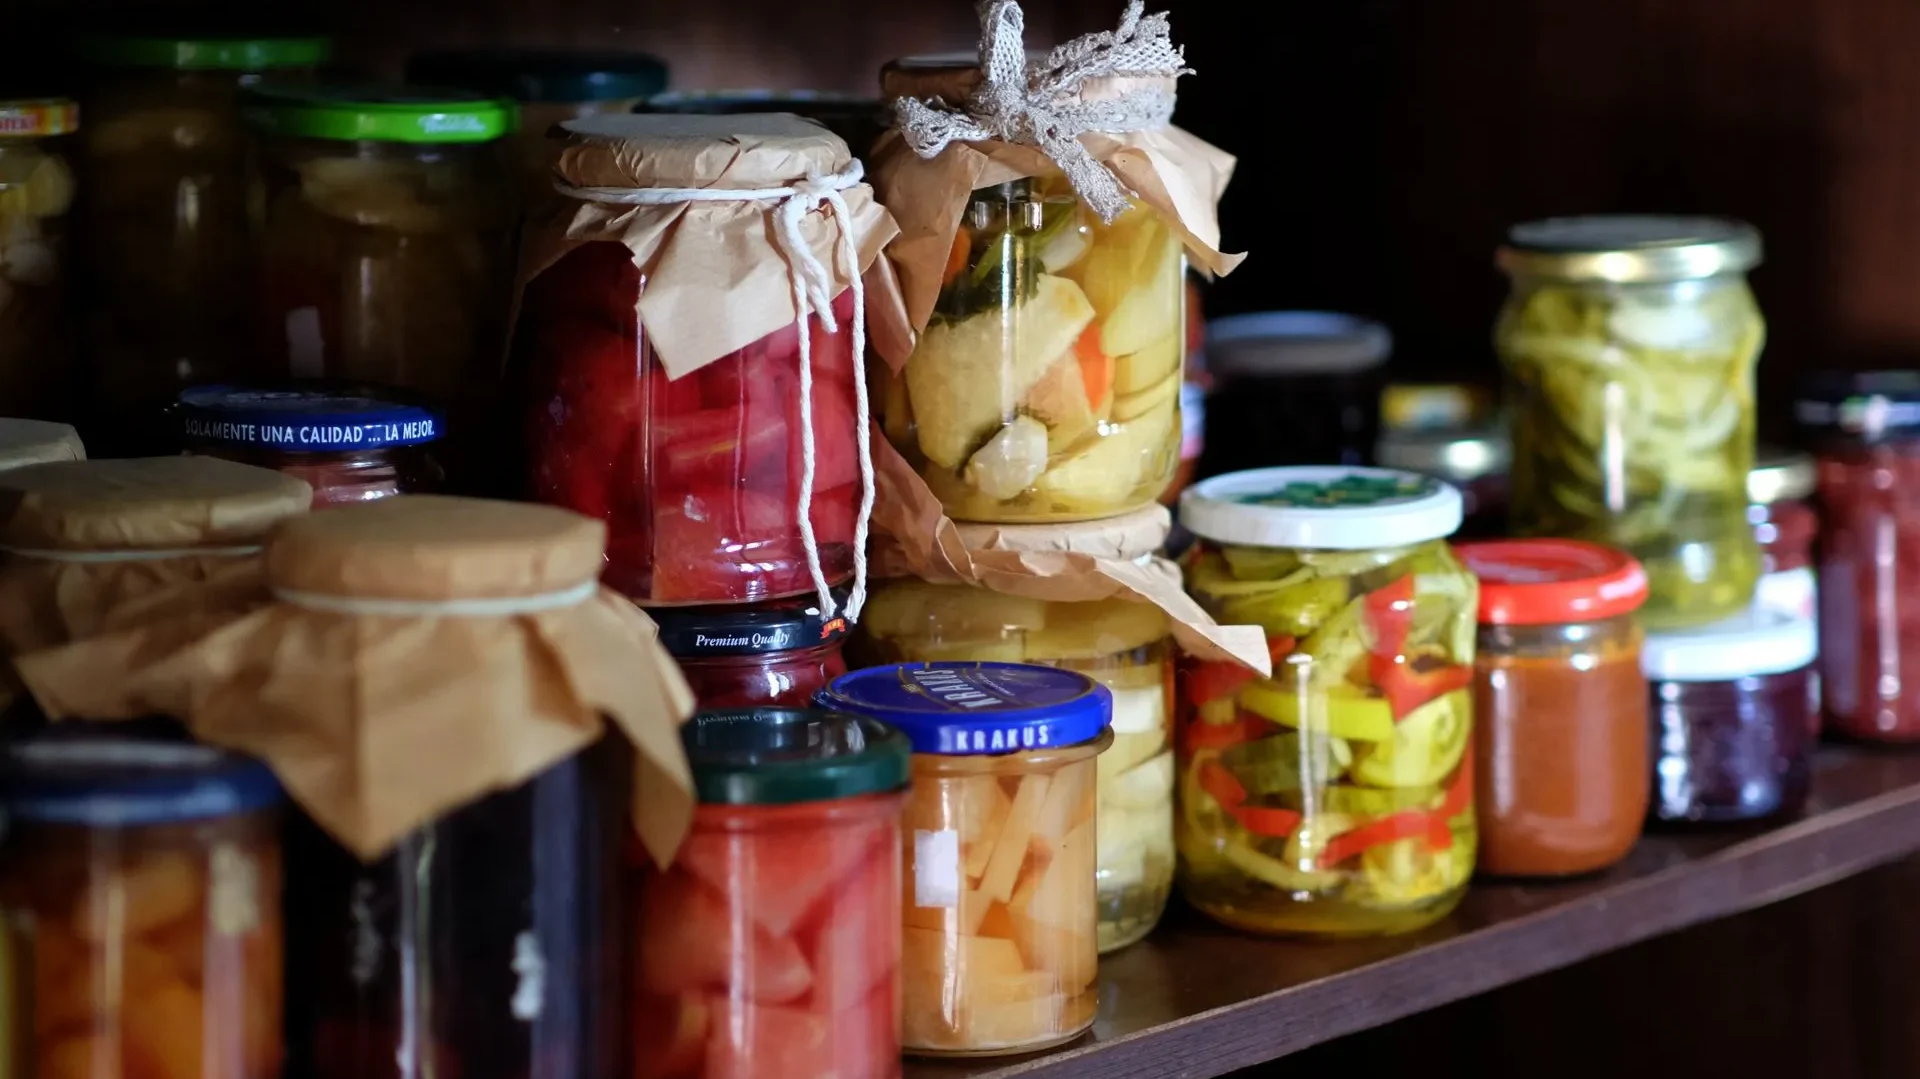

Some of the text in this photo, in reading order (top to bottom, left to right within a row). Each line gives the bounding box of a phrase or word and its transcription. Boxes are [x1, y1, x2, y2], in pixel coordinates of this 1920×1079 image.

[185, 419, 255, 441] SOLAMENTE
[261, 426, 294, 443] UNA
[300, 426, 363, 443] CALIDAD
[385, 425, 399, 441] LA
[403, 419, 435, 439] MEJOR.
[695, 628, 790, 648] Premium Quality
[913, 669, 1002, 708] KRAKUS
[957, 725, 1049, 750] KRAKUS
